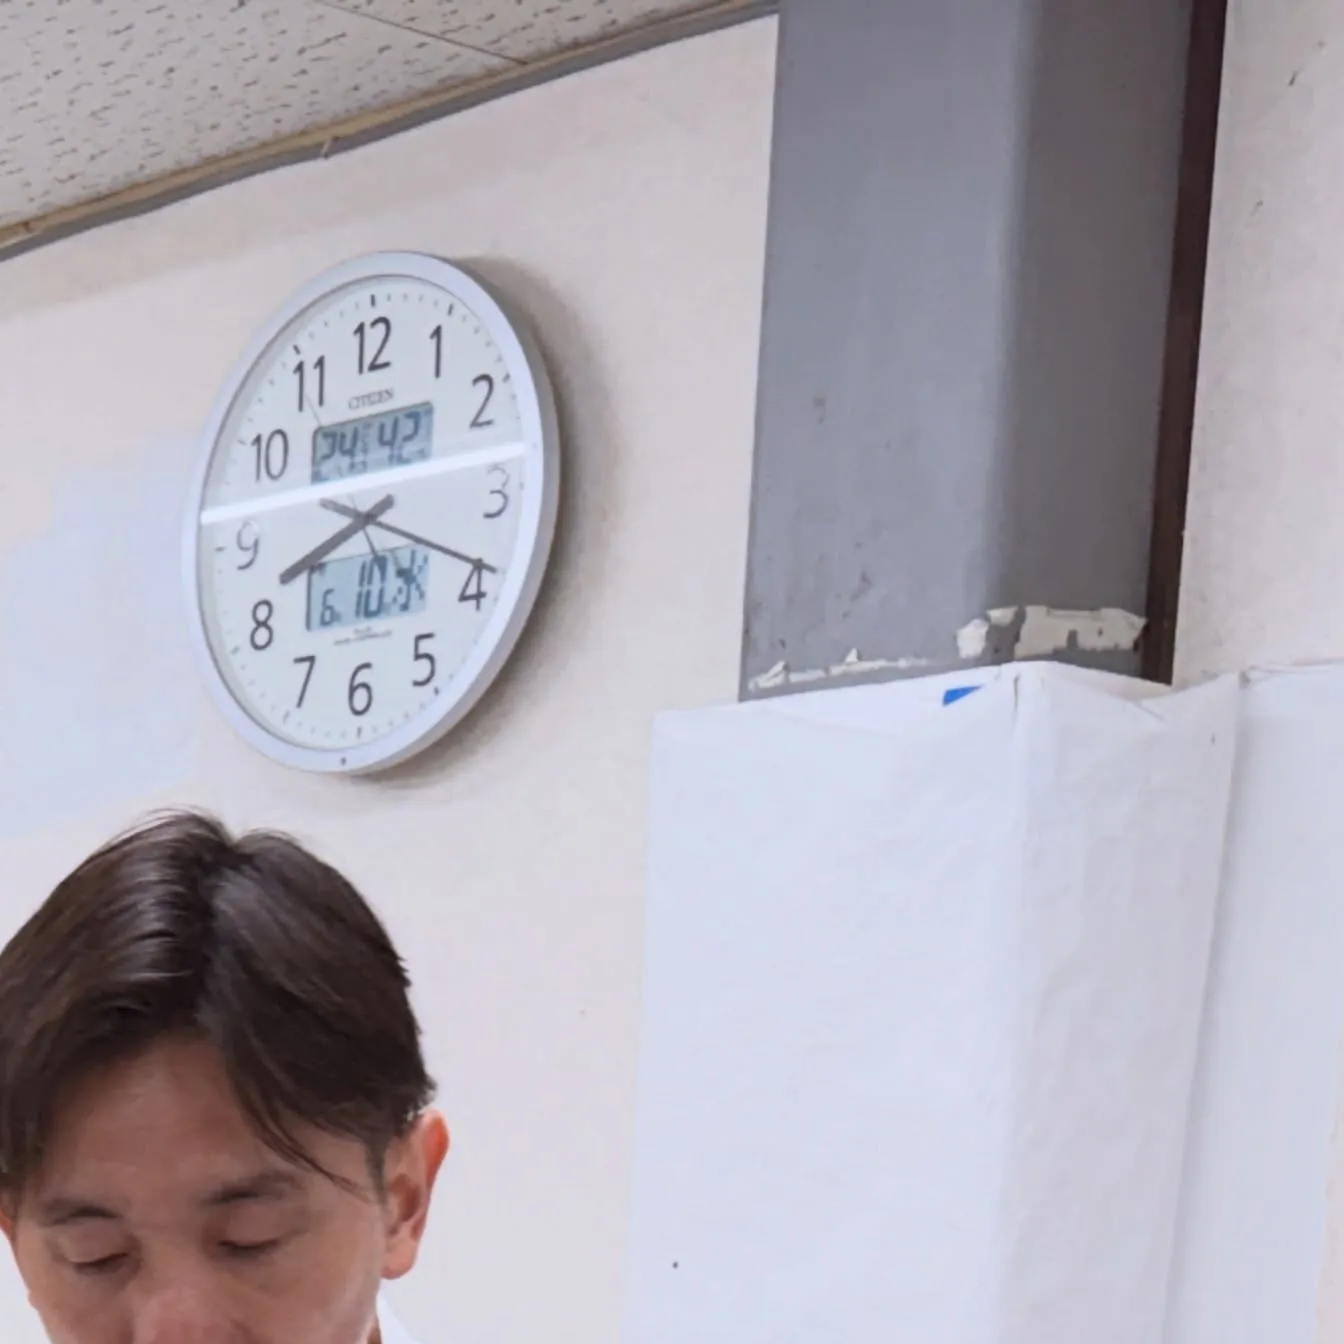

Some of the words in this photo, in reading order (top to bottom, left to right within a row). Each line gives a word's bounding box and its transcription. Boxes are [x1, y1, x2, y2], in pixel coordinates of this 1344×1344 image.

[352, 317, 393, 375] 12
[429, 324, 444, 378] 1
[292, 355, 327, 413] 11
[469, 374, 496, 429] 2
[250, 429, 290, 482] 10
[482, 465, 510, 519] 3
[235, 519, 260, 571] 9
[458, 559, 488, 612] 4
[249, 599, 274, 651] 8
[292, 655, 317, 709] 7
[412, 633, 437, 687] 5
[347, 662, 373, 716] 6
